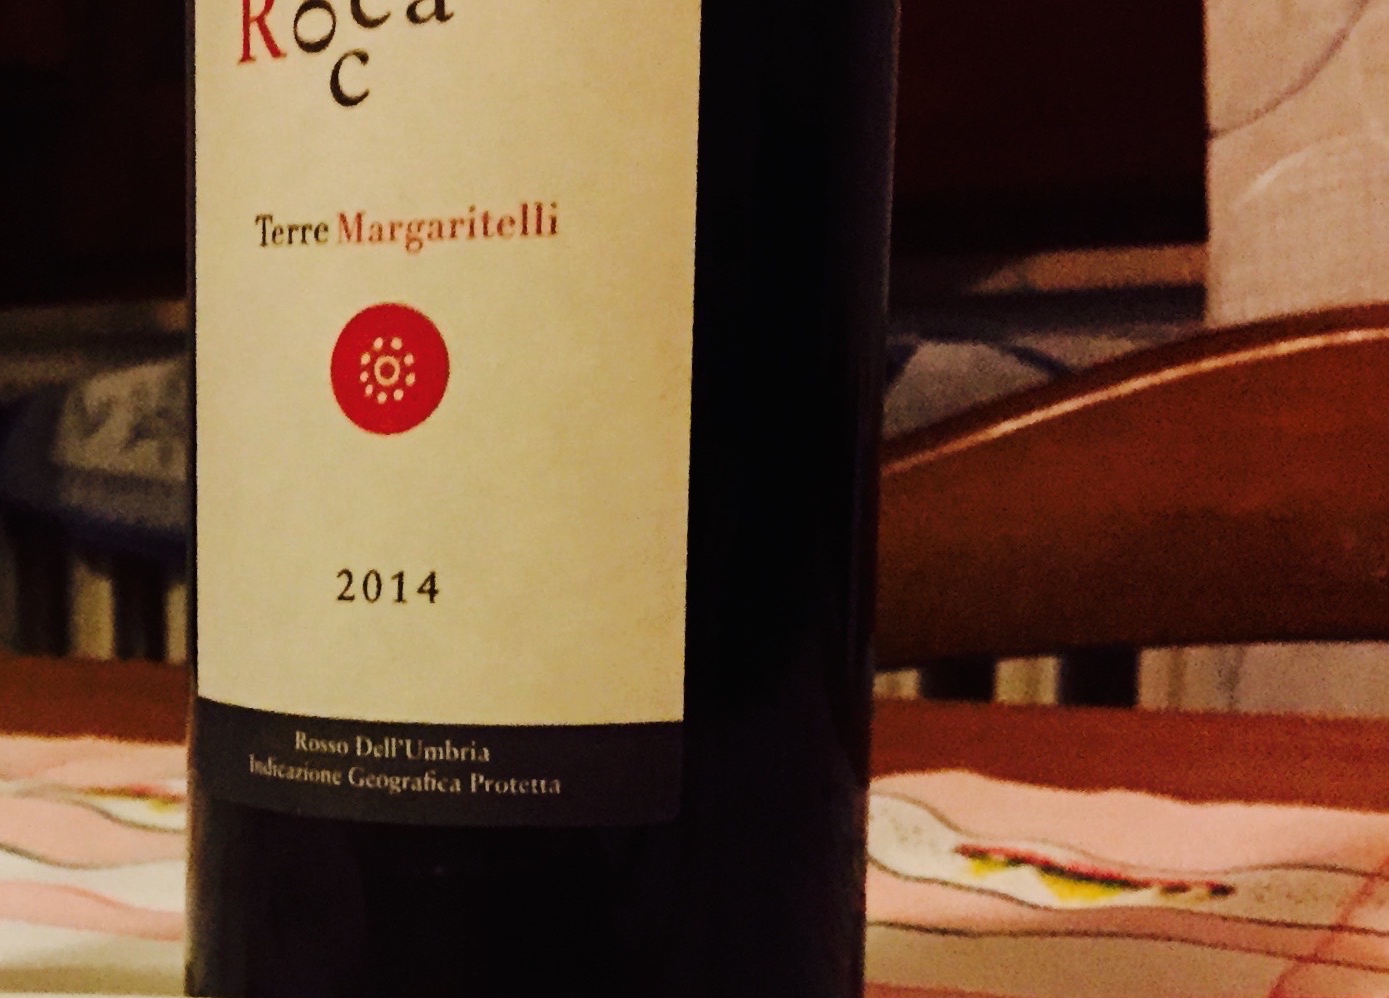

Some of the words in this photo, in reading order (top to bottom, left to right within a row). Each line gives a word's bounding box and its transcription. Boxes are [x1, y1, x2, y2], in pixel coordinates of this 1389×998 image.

[255, 214, 329, 247] Terre
[337, 202, 560, 254] Margaritelli
[336, 569, 440, 604] 2014
[294, 731, 350, 758] Rosso
[356, 735, 491, 763] Dell'Umbria
[248, 755, 342, 786] Indicazione
[348, 767, 462, 795] Geografica
[470, 773, 562, 796] Protetta
